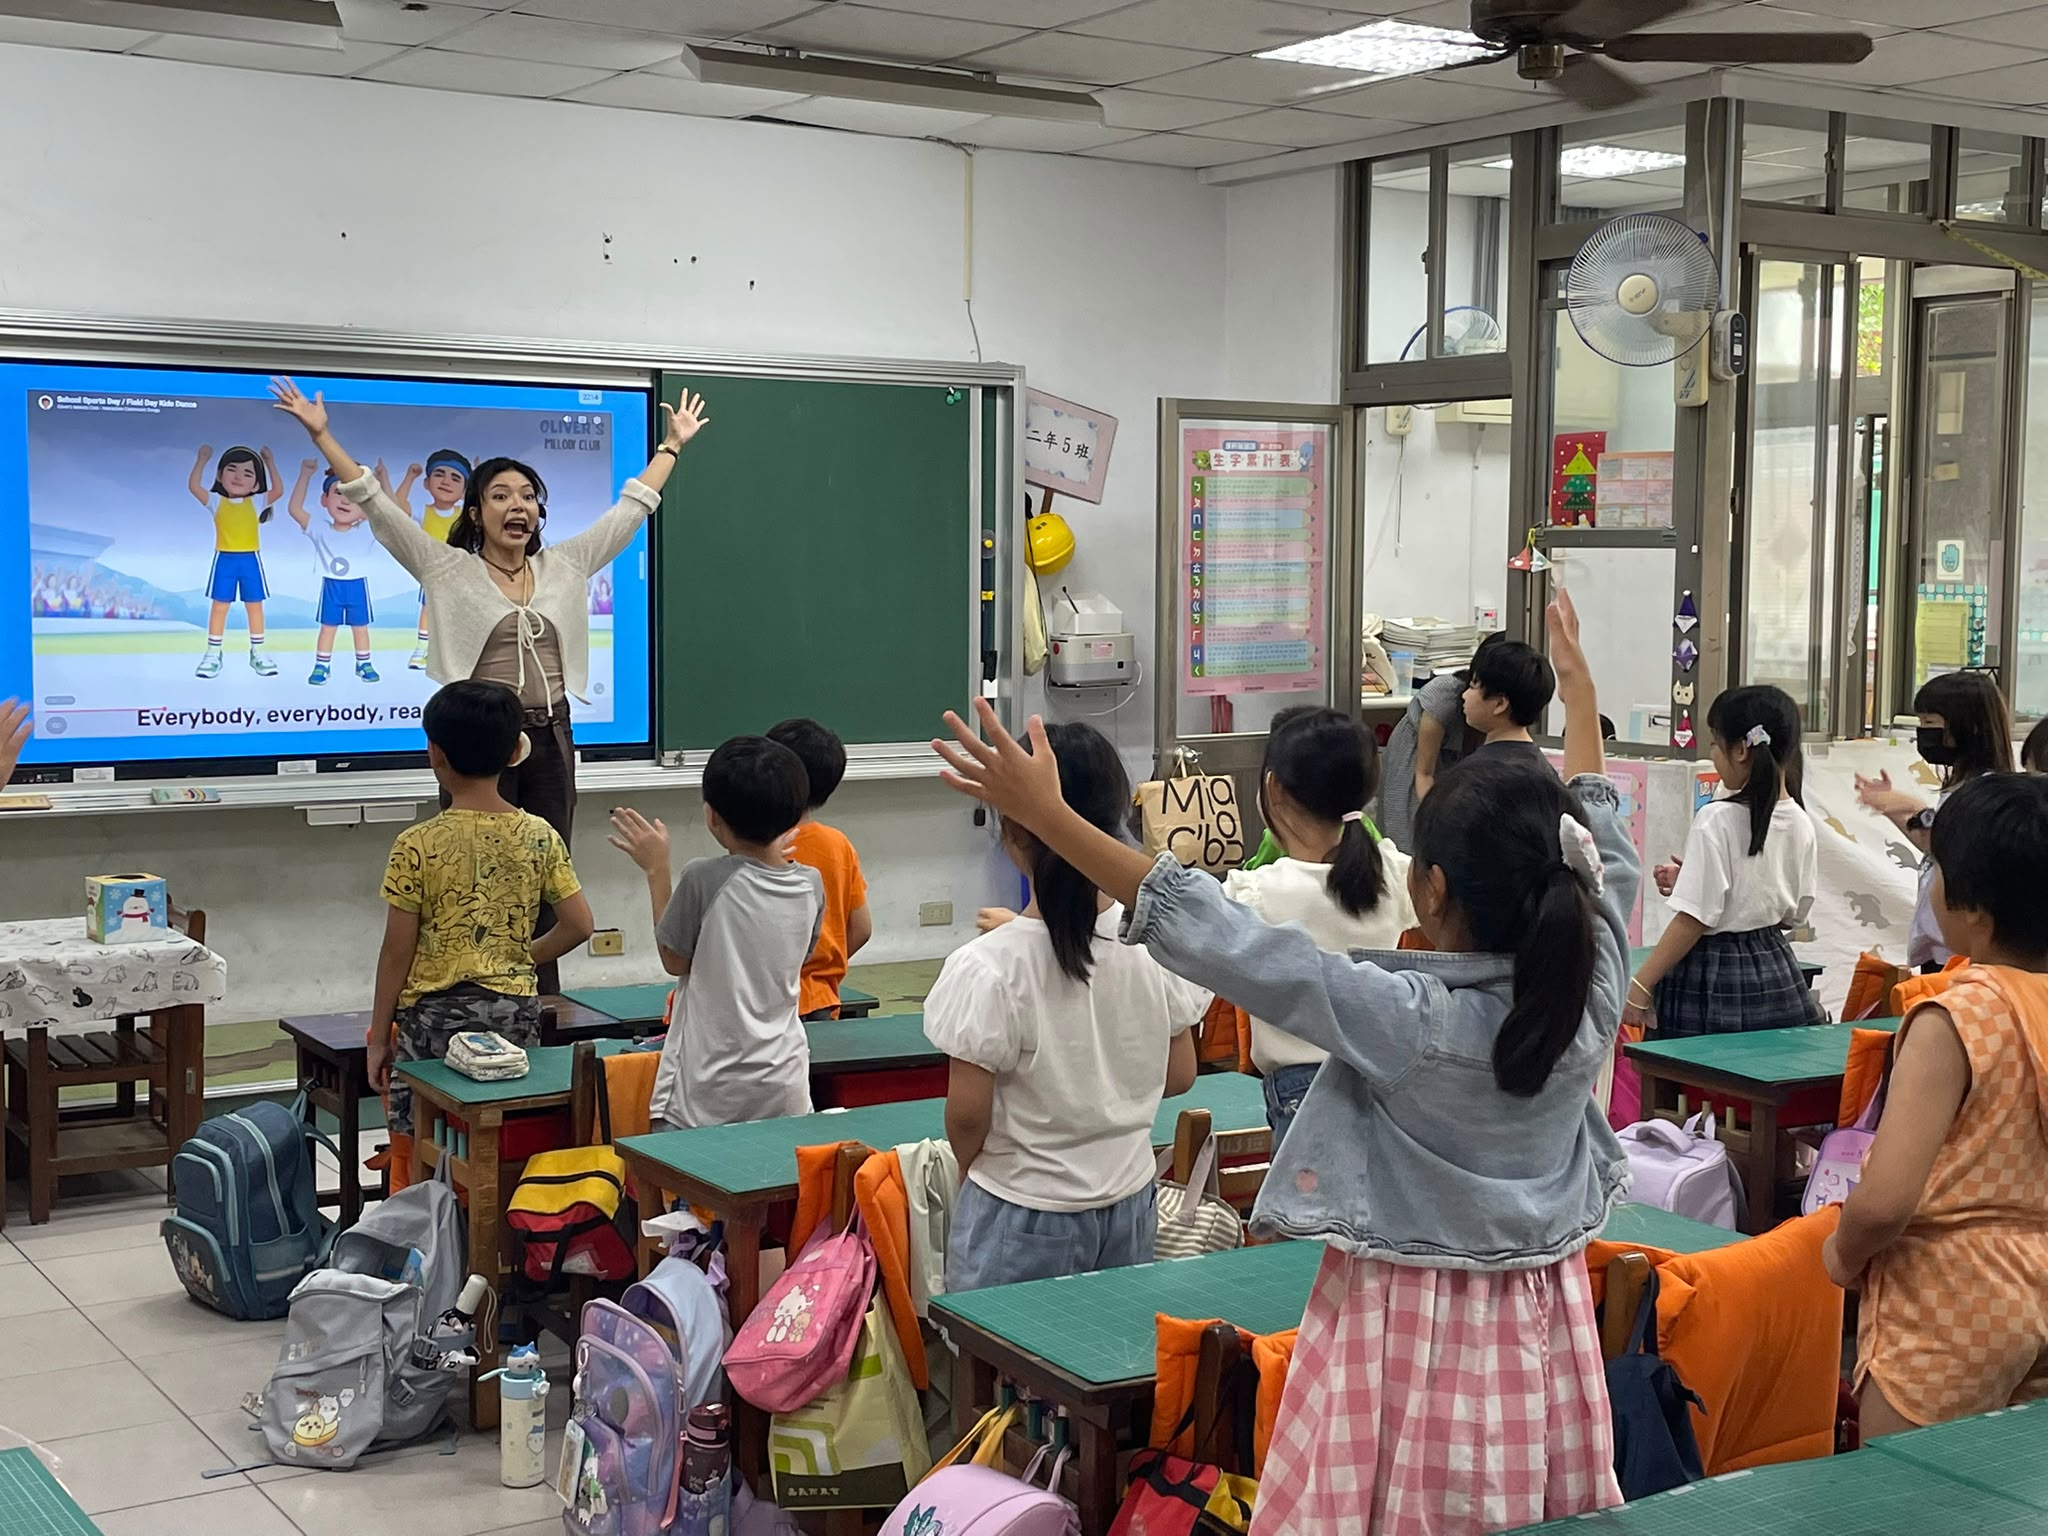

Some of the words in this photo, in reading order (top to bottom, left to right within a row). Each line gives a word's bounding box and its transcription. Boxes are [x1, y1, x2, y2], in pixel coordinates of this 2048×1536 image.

[107, 397, 120, 406] Day
[144, 399, 158, 408] Day
[578, 439, 600, 451] CLUB
[1213, 453, 1291, 467] 生字累計表
[138, 708, 260, 729] Everybody,
[267, 703, 384, 725] everybody,
[389, 704, 421, 720] rea
[1162, 777, 1235, 820] Mia
